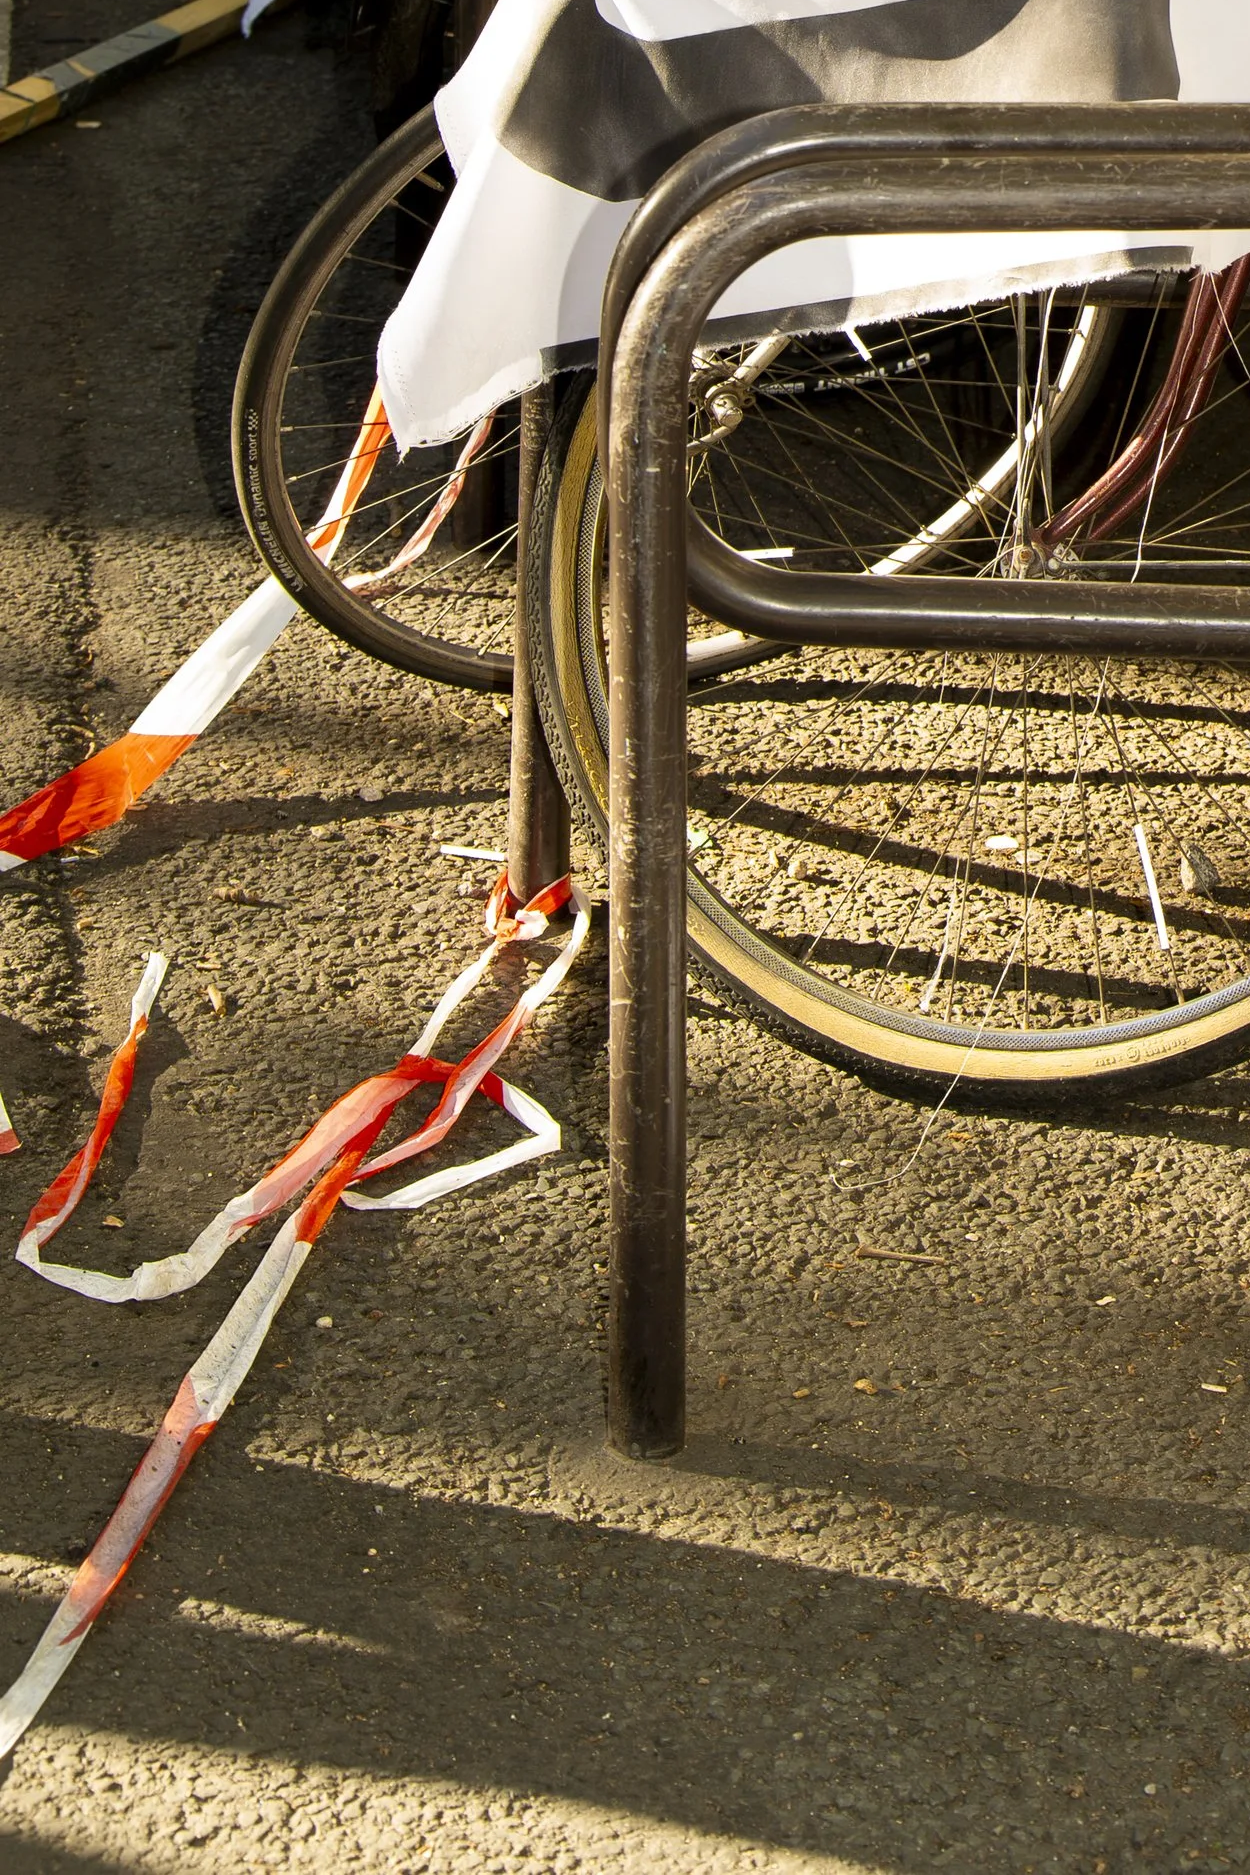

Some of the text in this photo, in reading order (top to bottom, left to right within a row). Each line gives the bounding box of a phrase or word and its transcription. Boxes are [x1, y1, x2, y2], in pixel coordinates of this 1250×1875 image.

[895, 352, 931, 375] CST
[248, 433, 258, 461] sport
[256, 520, 296, 578] MICHELIN
